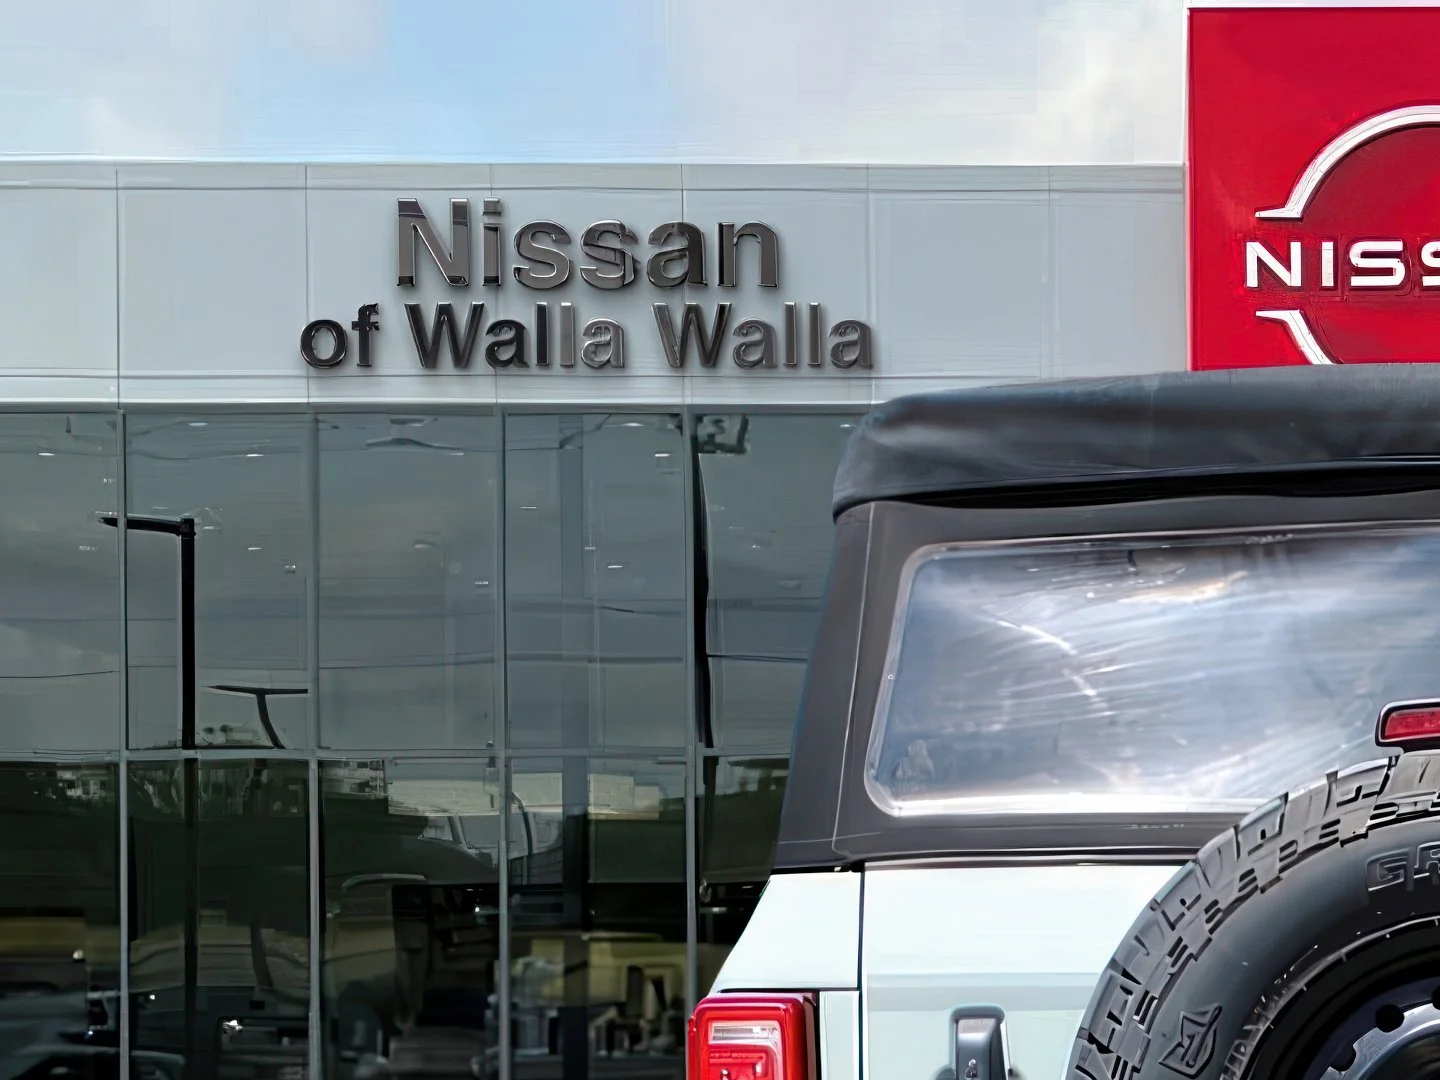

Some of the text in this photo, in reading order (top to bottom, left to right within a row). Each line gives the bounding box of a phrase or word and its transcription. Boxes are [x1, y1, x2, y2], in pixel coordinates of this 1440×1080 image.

[397, 197, 781, 290] Nissan
[299, 301, 876, 370] of Walla Walla
